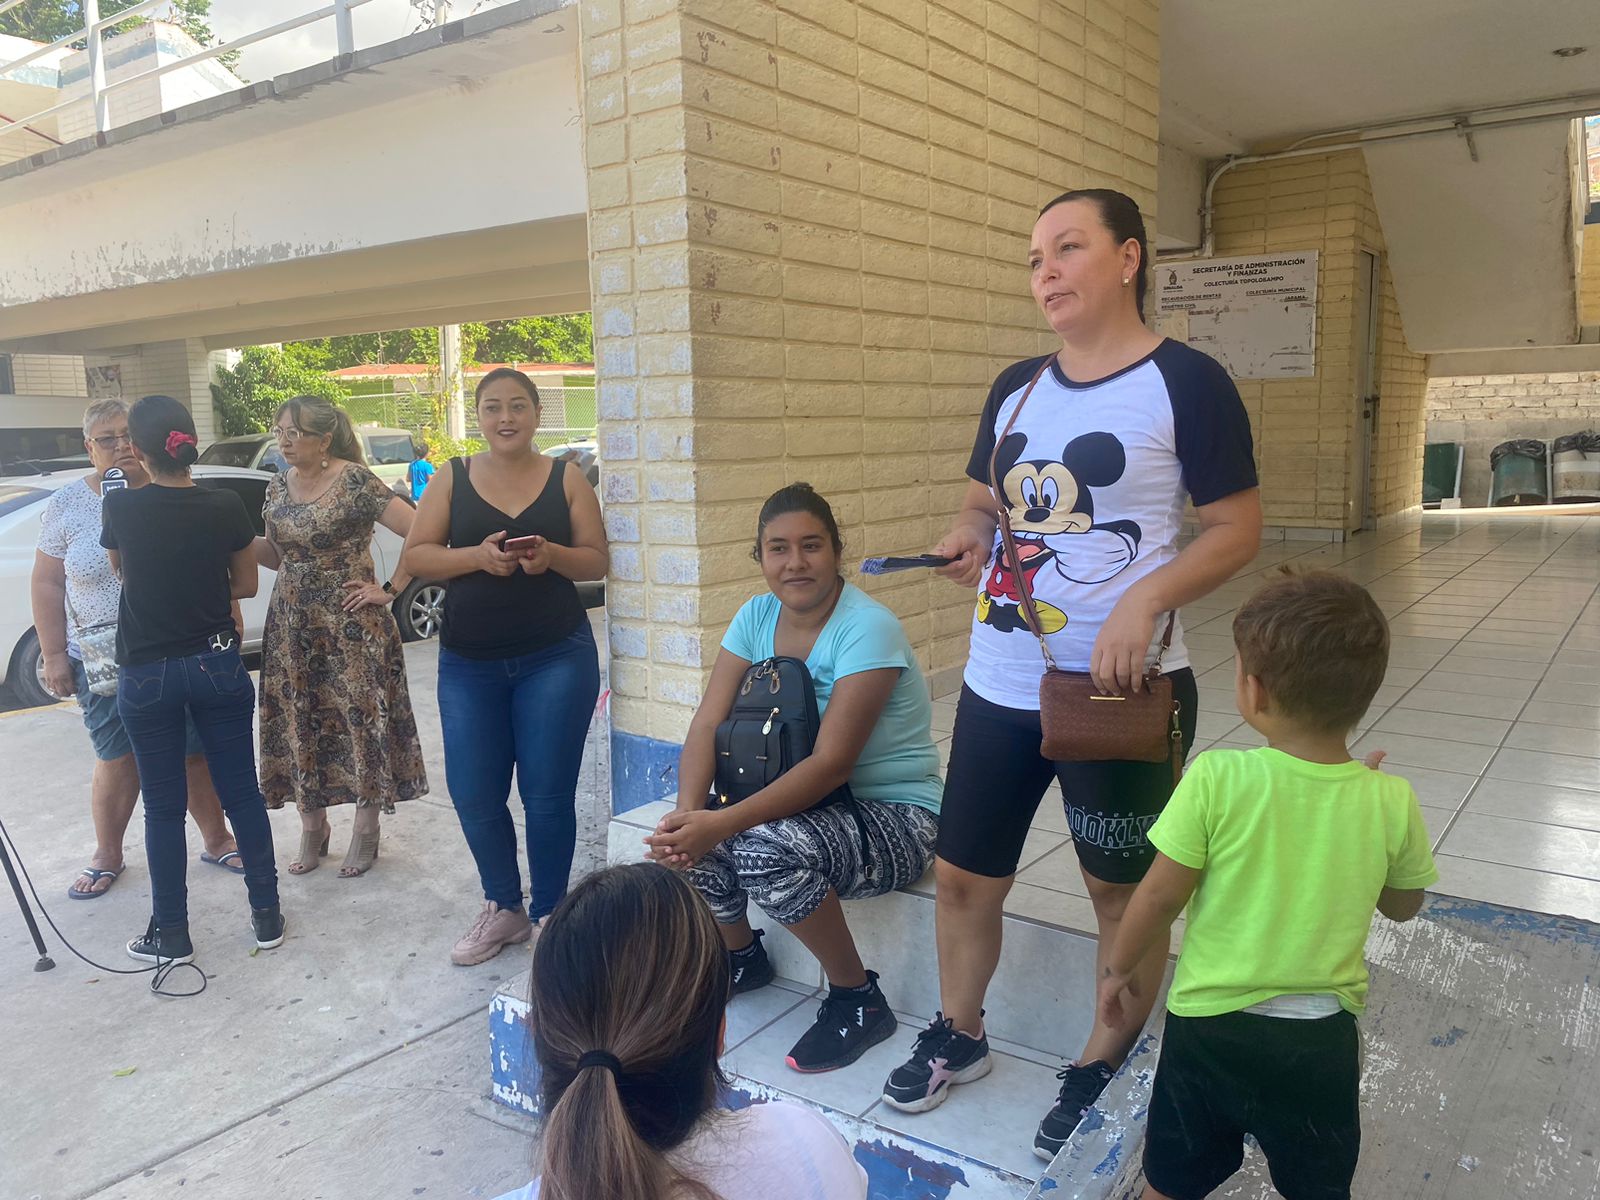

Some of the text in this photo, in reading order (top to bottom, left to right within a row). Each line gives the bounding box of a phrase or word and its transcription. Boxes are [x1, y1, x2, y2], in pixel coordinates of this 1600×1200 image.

[1193, 258, 1306, 274] SECRETARÍA DE ADMINISTRACIÓN
[1233, 269, 1268, 277] FINANZAS
[1204, 276, 1284, 287] COLECTURÍA TOPOLOBAMPO
